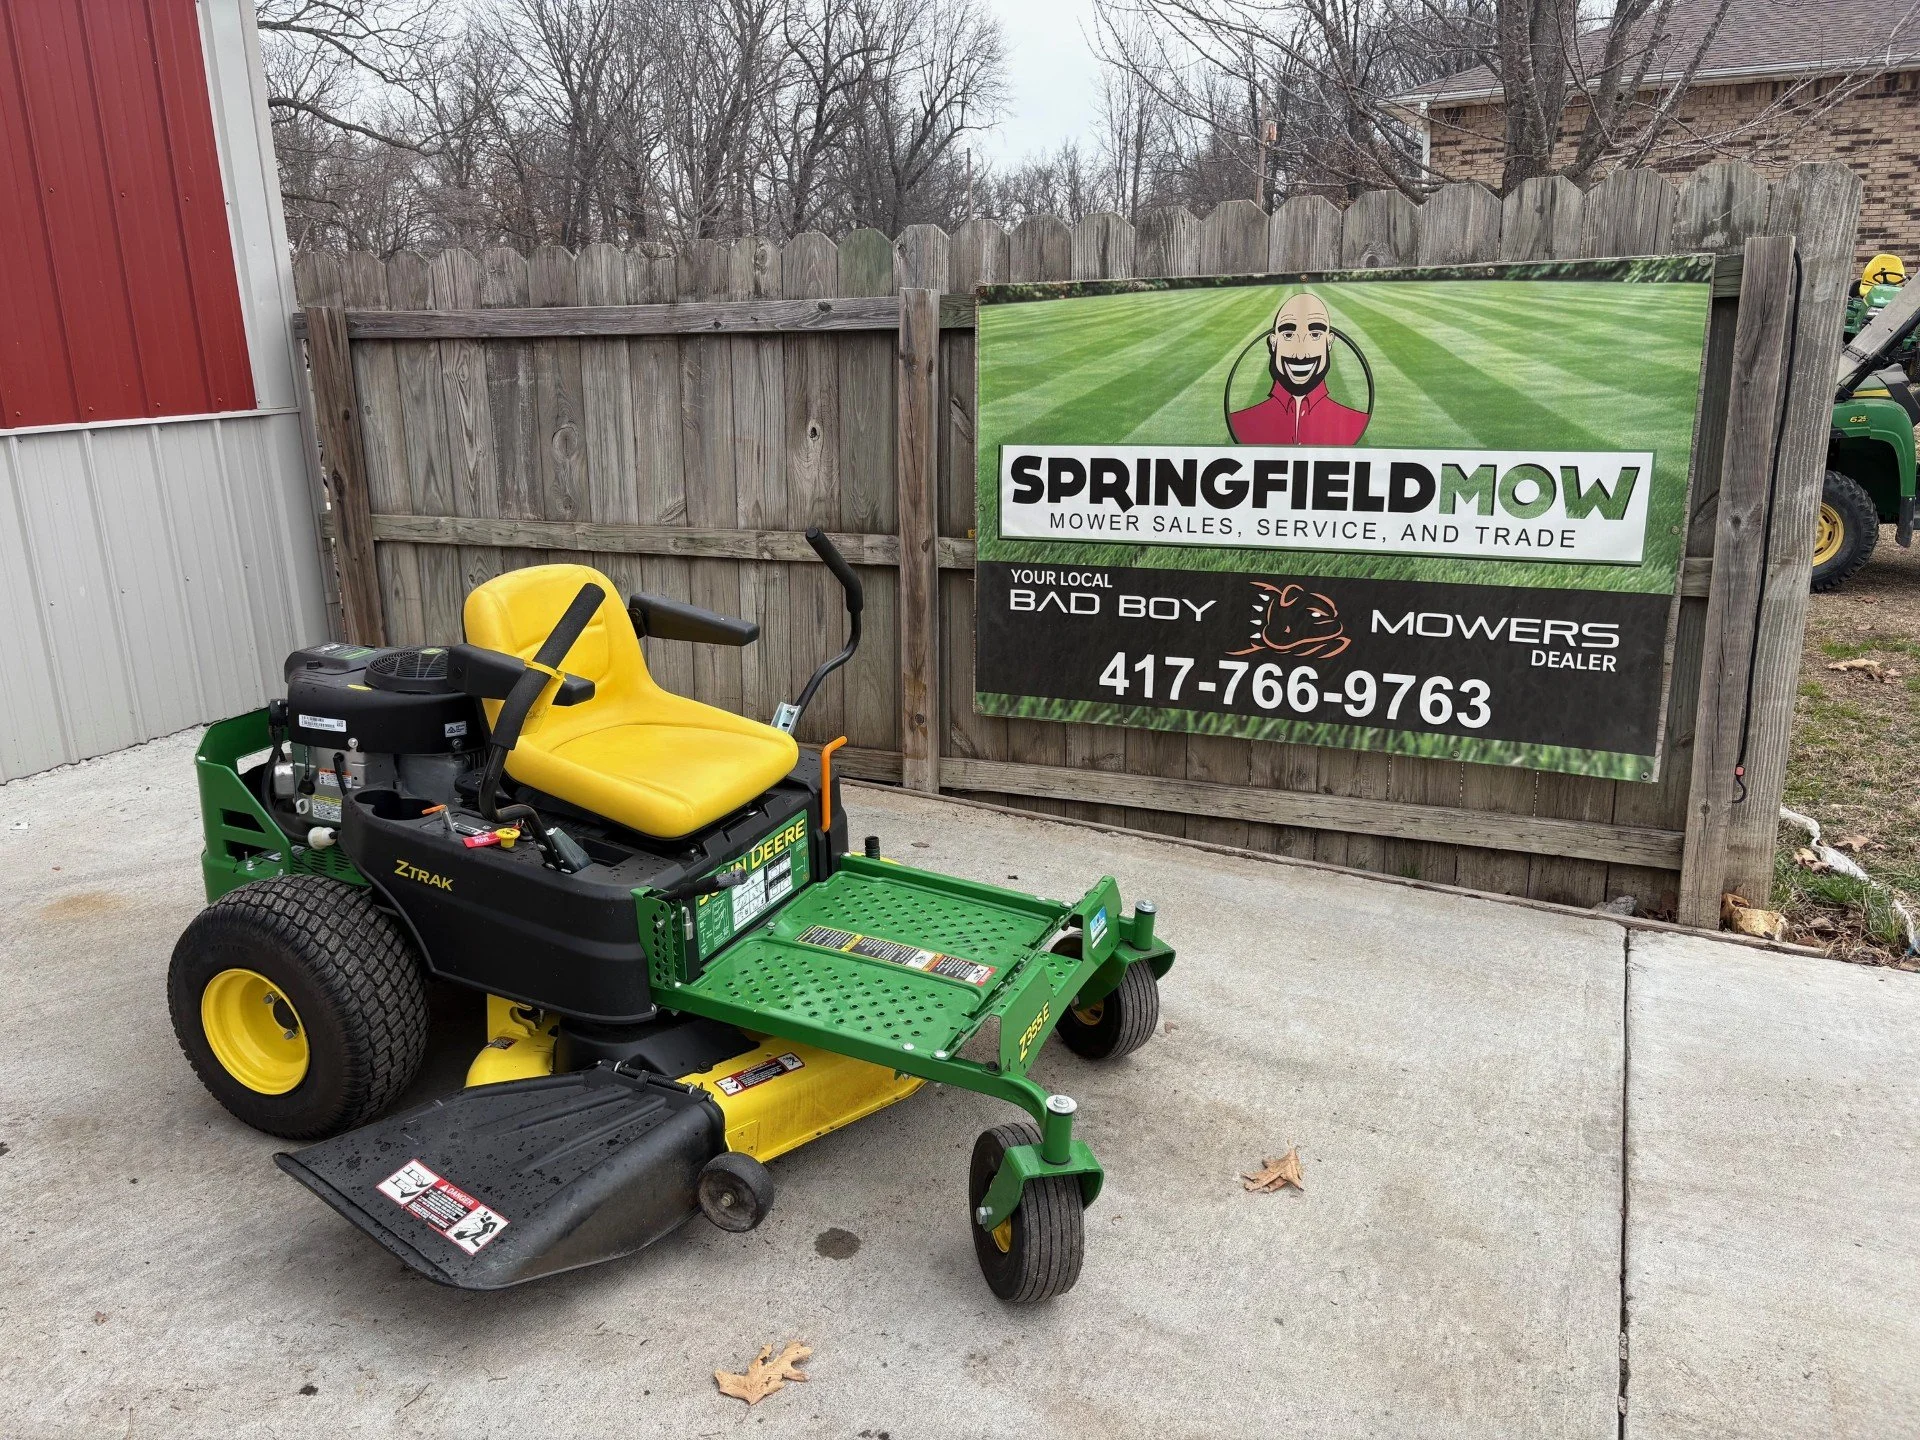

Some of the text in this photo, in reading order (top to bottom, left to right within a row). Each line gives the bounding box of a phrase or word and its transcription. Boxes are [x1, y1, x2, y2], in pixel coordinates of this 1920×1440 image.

[1010, 455, 1641, 520] SPRINGFIELDMOW
[1050, 512, 1577, 548] MOWER SALES, SERVICE, AND TRADE
[1010, 568, 1113, 588] YOUR LOCAL
[1009, 589, 1621, 649] BAD BOY MOWERS
[1530, 649, 1617, 672] DEALER
[1099, 651, 1492, 729] 417-766-9763
[751, 818, 805, 870] DEERE
[445, 1187, 474, 1206] DANGER
